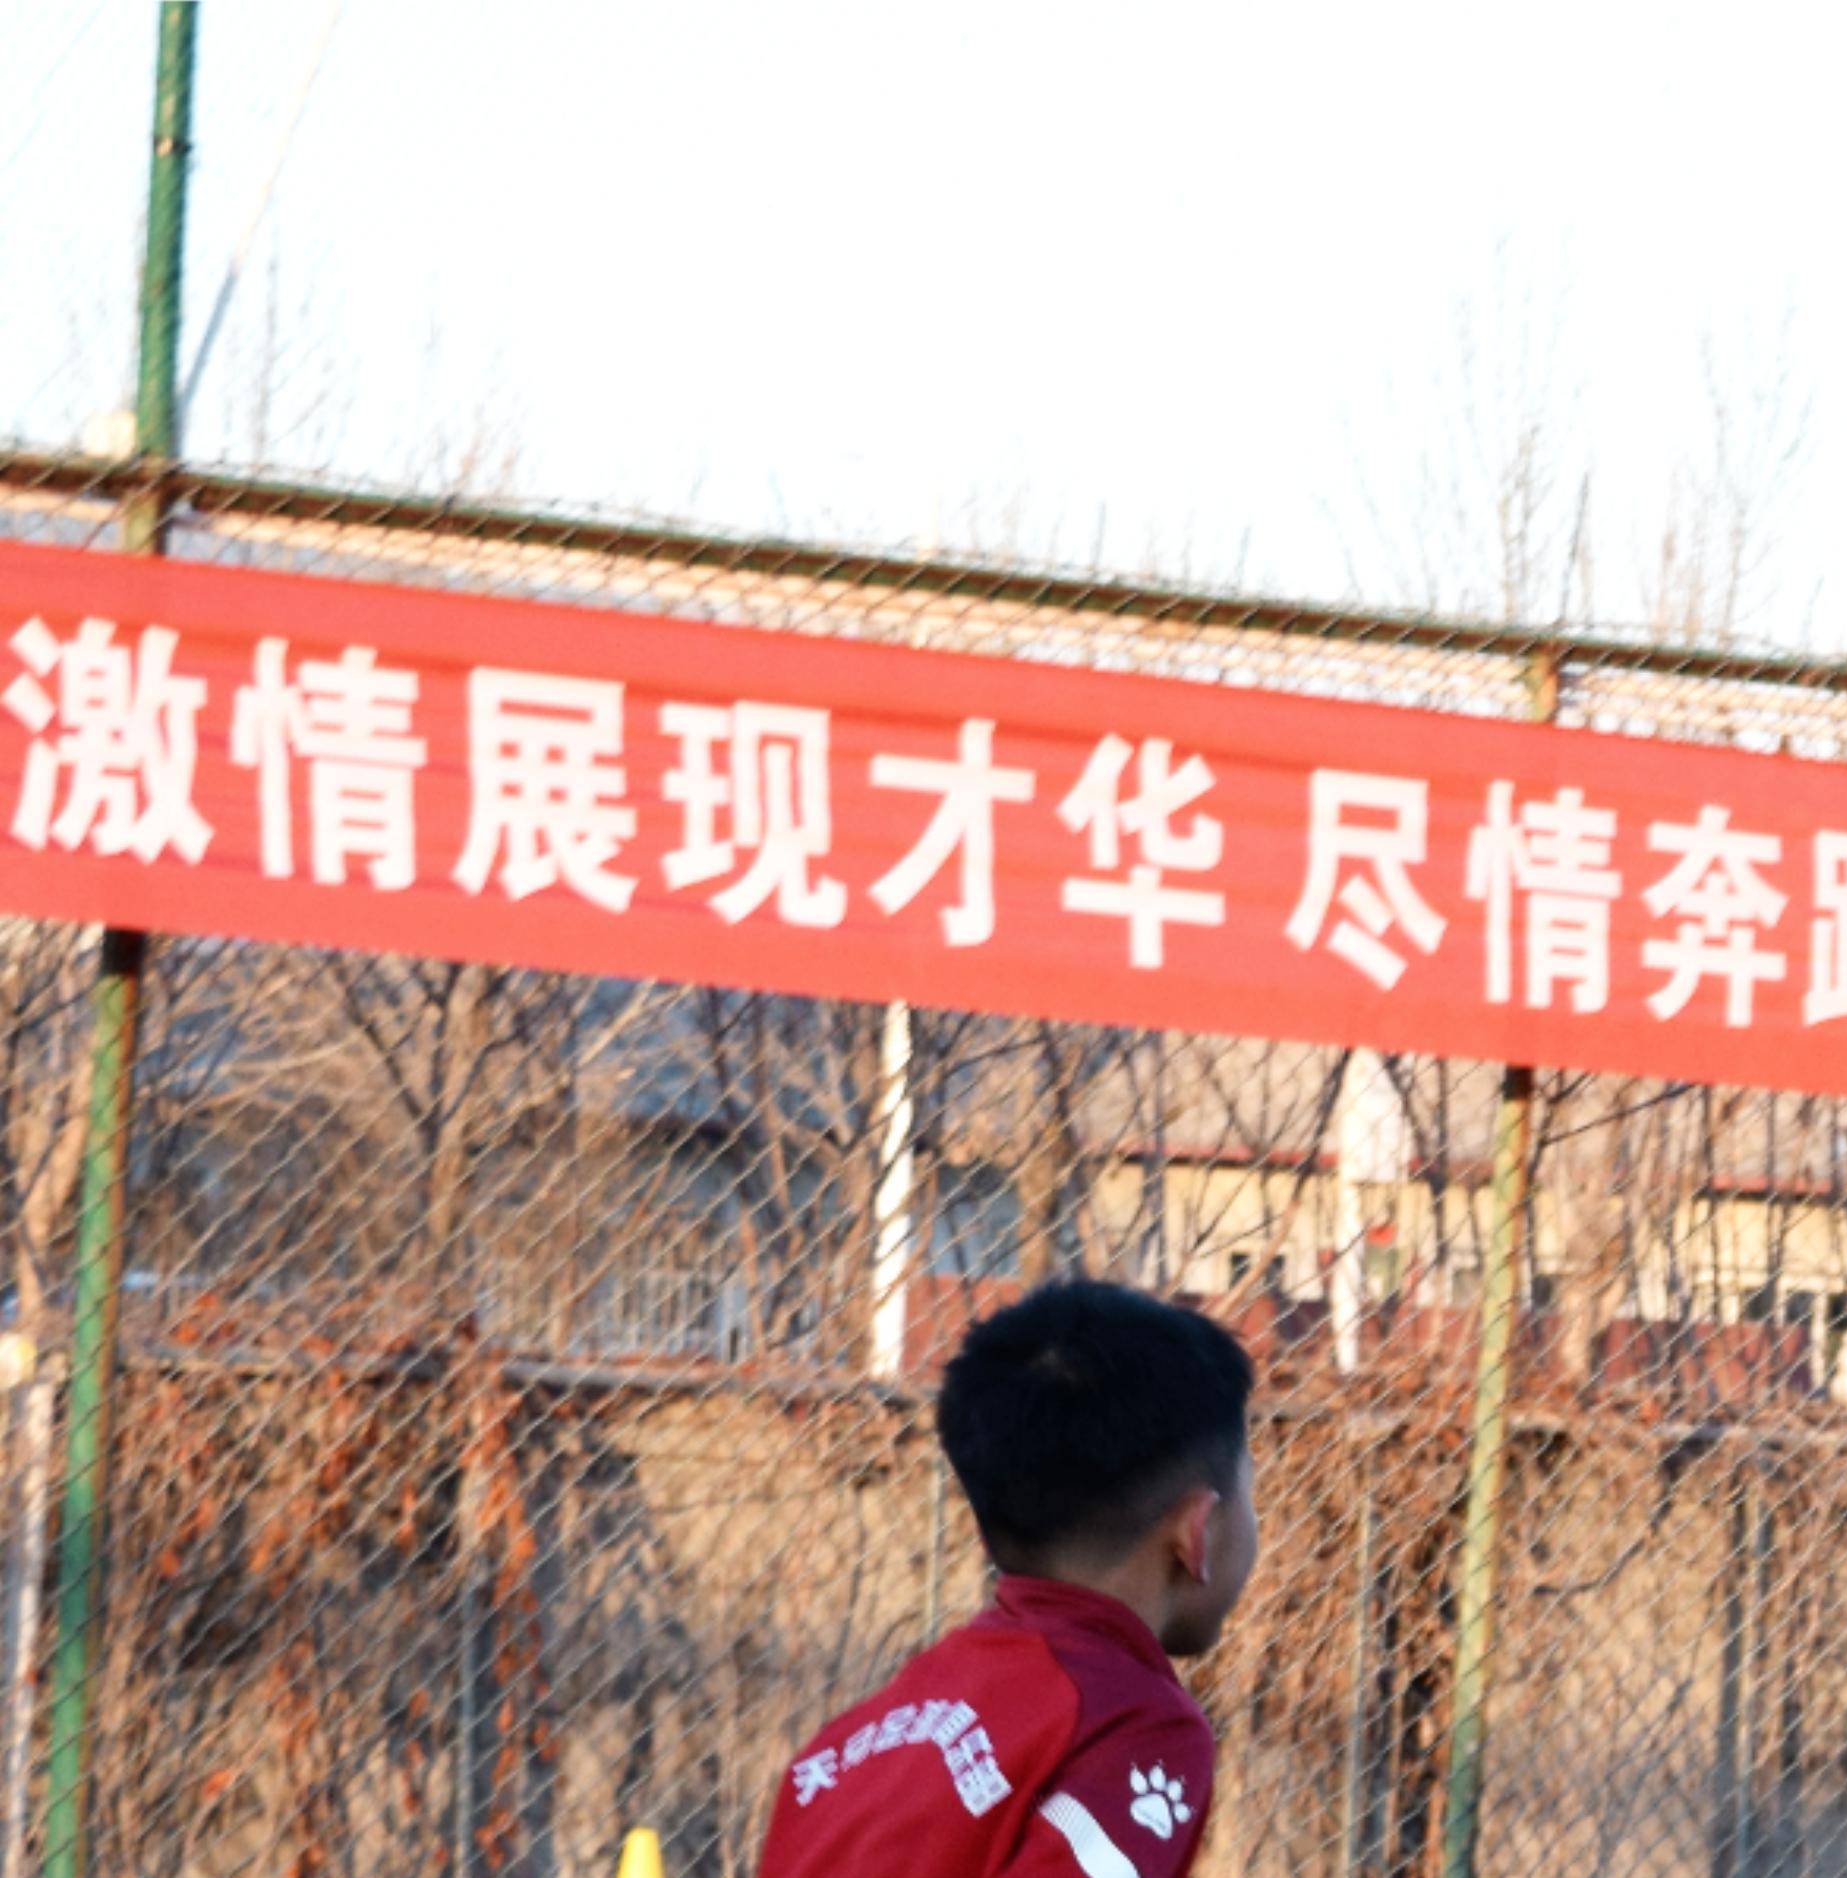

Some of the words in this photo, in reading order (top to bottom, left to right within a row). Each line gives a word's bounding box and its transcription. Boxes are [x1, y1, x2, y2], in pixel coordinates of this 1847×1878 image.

[3, 617, 1225, 969] 激情展现才华
